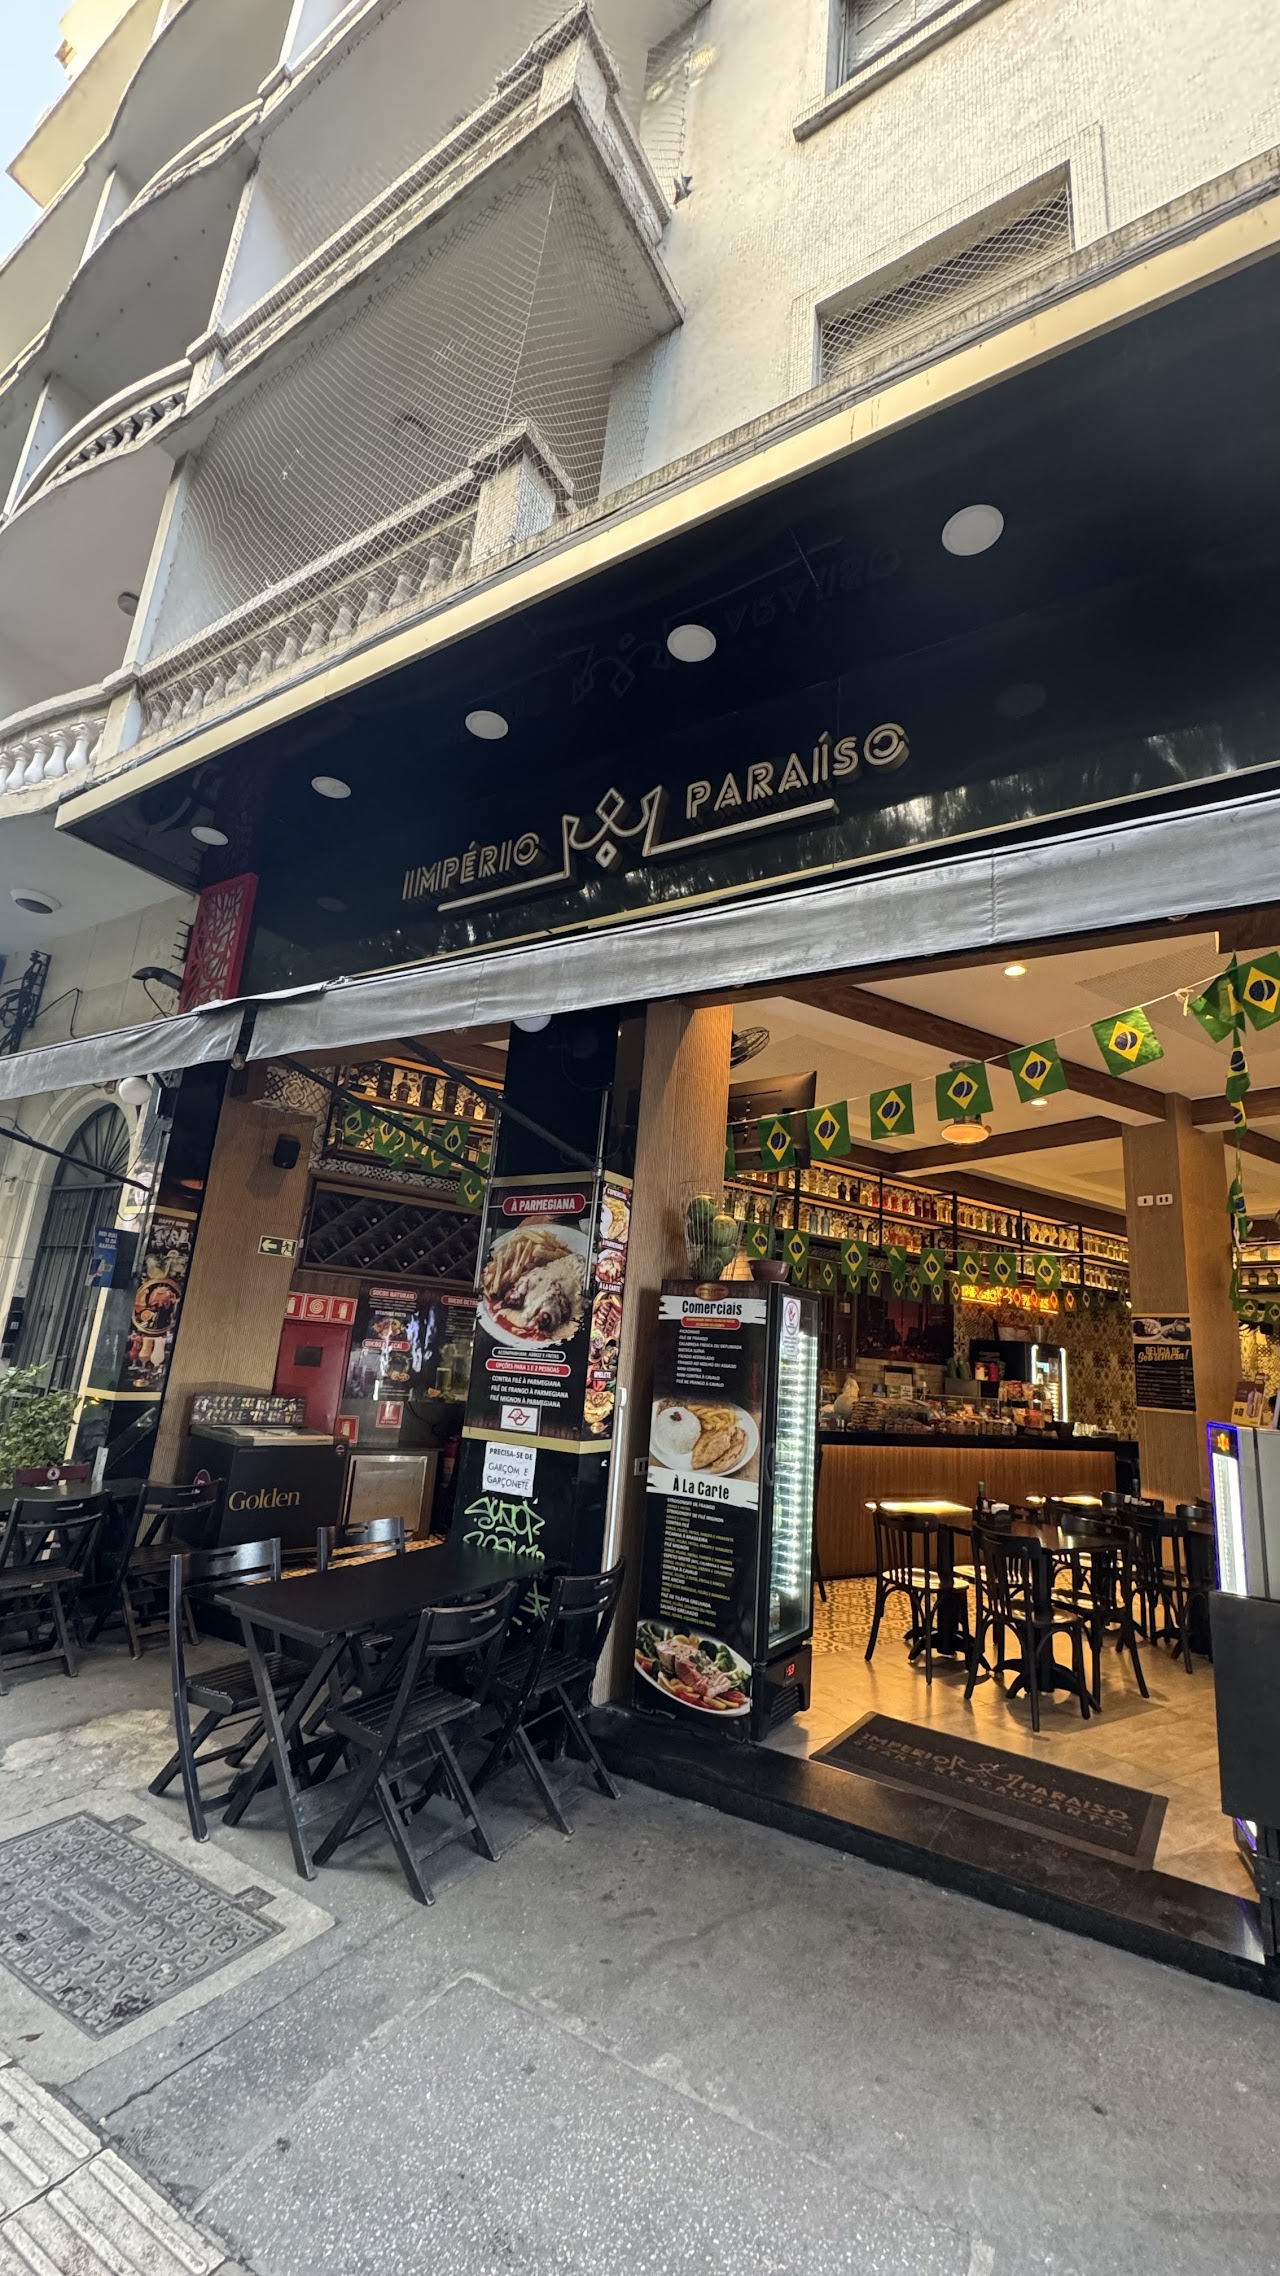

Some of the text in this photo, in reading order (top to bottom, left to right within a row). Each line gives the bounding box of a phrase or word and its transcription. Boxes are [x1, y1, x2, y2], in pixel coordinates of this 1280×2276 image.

[402, 722, 909, 901] IMPÉRIO PARAÍSO
[511, 1198, 576, 1212] À PARMEGIANA
[372, 1289, 415, 1299] SUCOS NATURAIS
[609, 1283, 621, 1292] CARTE
[682, 1300, 743, 1316] Comerciais
[495, 1362, 514, 1370] OPÇÕES
[513, 1363, 526, 1371] PARA
[539, 1365, 560, 1373] PESSOAS
[512, 1376, 522, 1384] FILÉ
[522, 1376, 527, 1384] À
[527, 1378, 561, 1387] PARMEGIANA
[508, 1386, 529, 1395] FRANGO
[529, 1387, 534, 1395] À
[534, 1389, 569, 1399] PARMEGIANA
[500, 1395, 521, 1404] MIGNON
[522, 1396, 527, 1404] À
[526, 1399, 561, 1408] PARMEGIANA
[489, 1448, 533, 1461] PRECISA-SE DE
[488, 1462, 529, 1477] GARÇOM E
[486, 1475, 529, 1491] GARÇONETE
[673, 1474, 730, 1500] À La Carte
[228, 1488, 301, 1512] Golden
[699, 1502, 716, 1511] FRANGO
